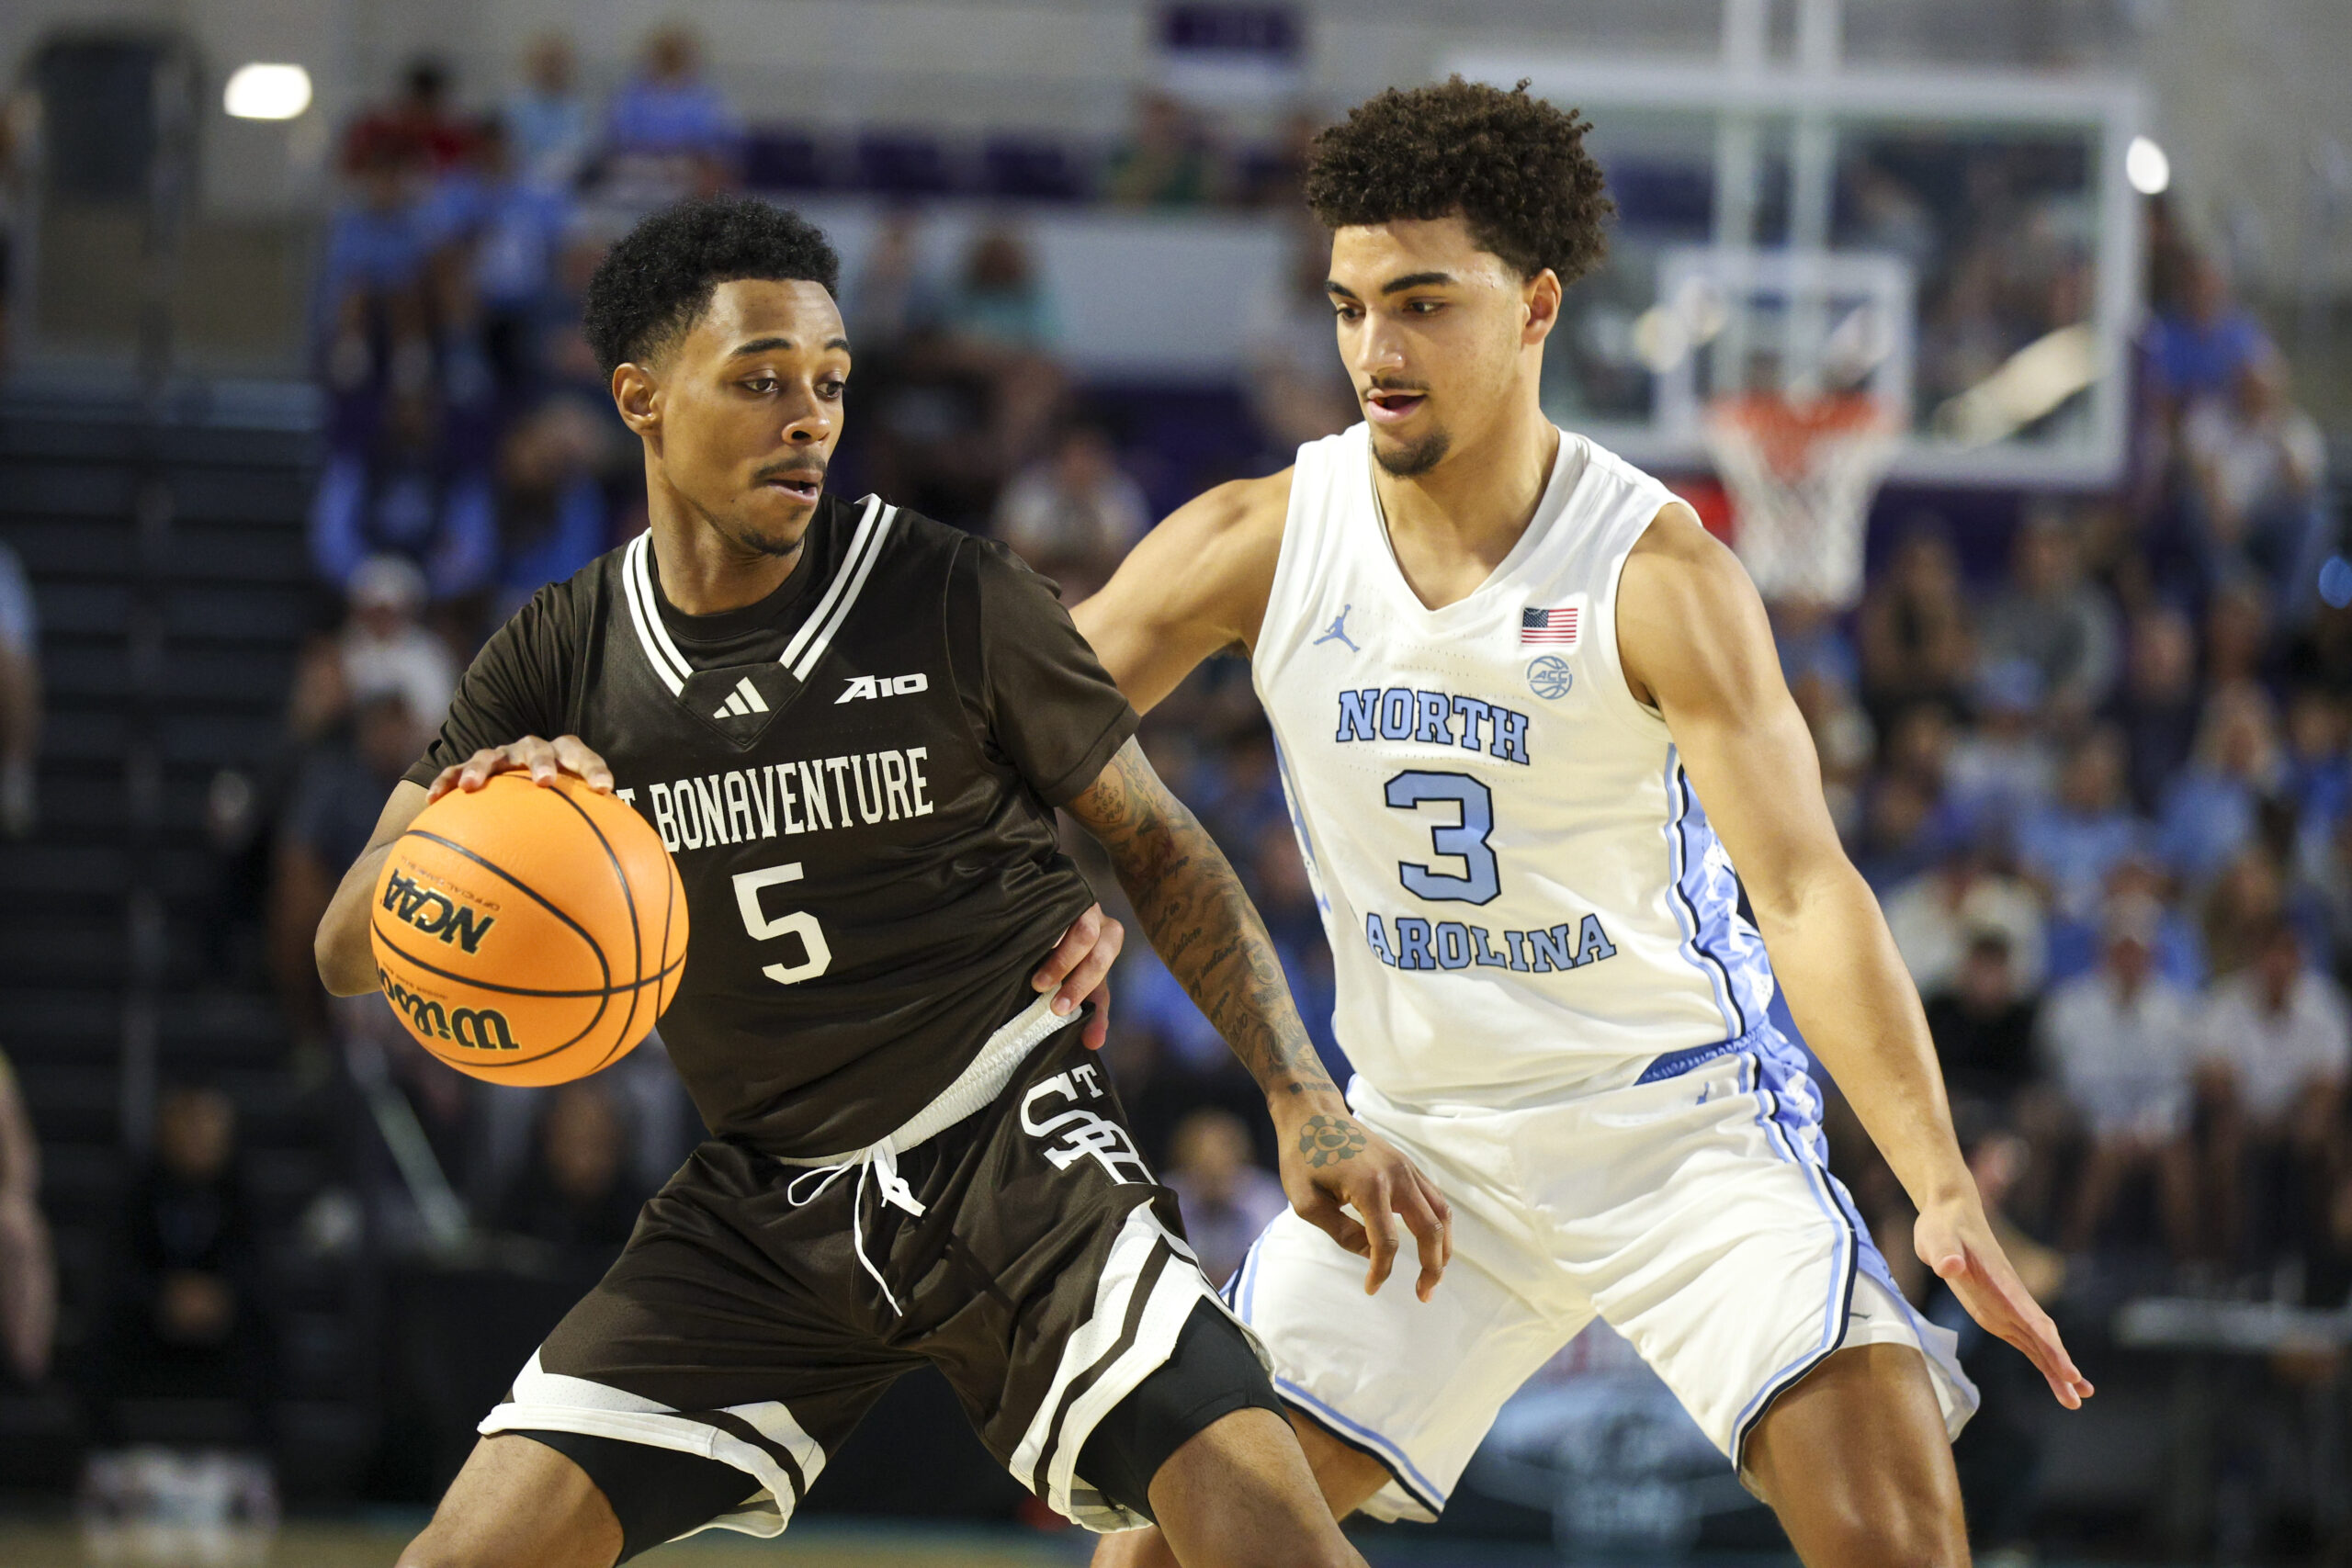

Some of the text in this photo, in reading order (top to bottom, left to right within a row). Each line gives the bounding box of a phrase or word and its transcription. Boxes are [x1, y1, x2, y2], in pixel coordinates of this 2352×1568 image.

[833, 672, 929, 705] A10
[1533, 670, 1570, 684] ACC
[1336, 687, 1530, 765] NORTH
[649, 746, 934, 853] BONAVENTURE
[1384, 769, 1502, 906] 3
[383, 867, 496, 955] NCAA
[731, 862, 832, 985] 5
[1365, 912, 1617, 974] AROLINA
[376, 960, 521, 1050] Wilso
